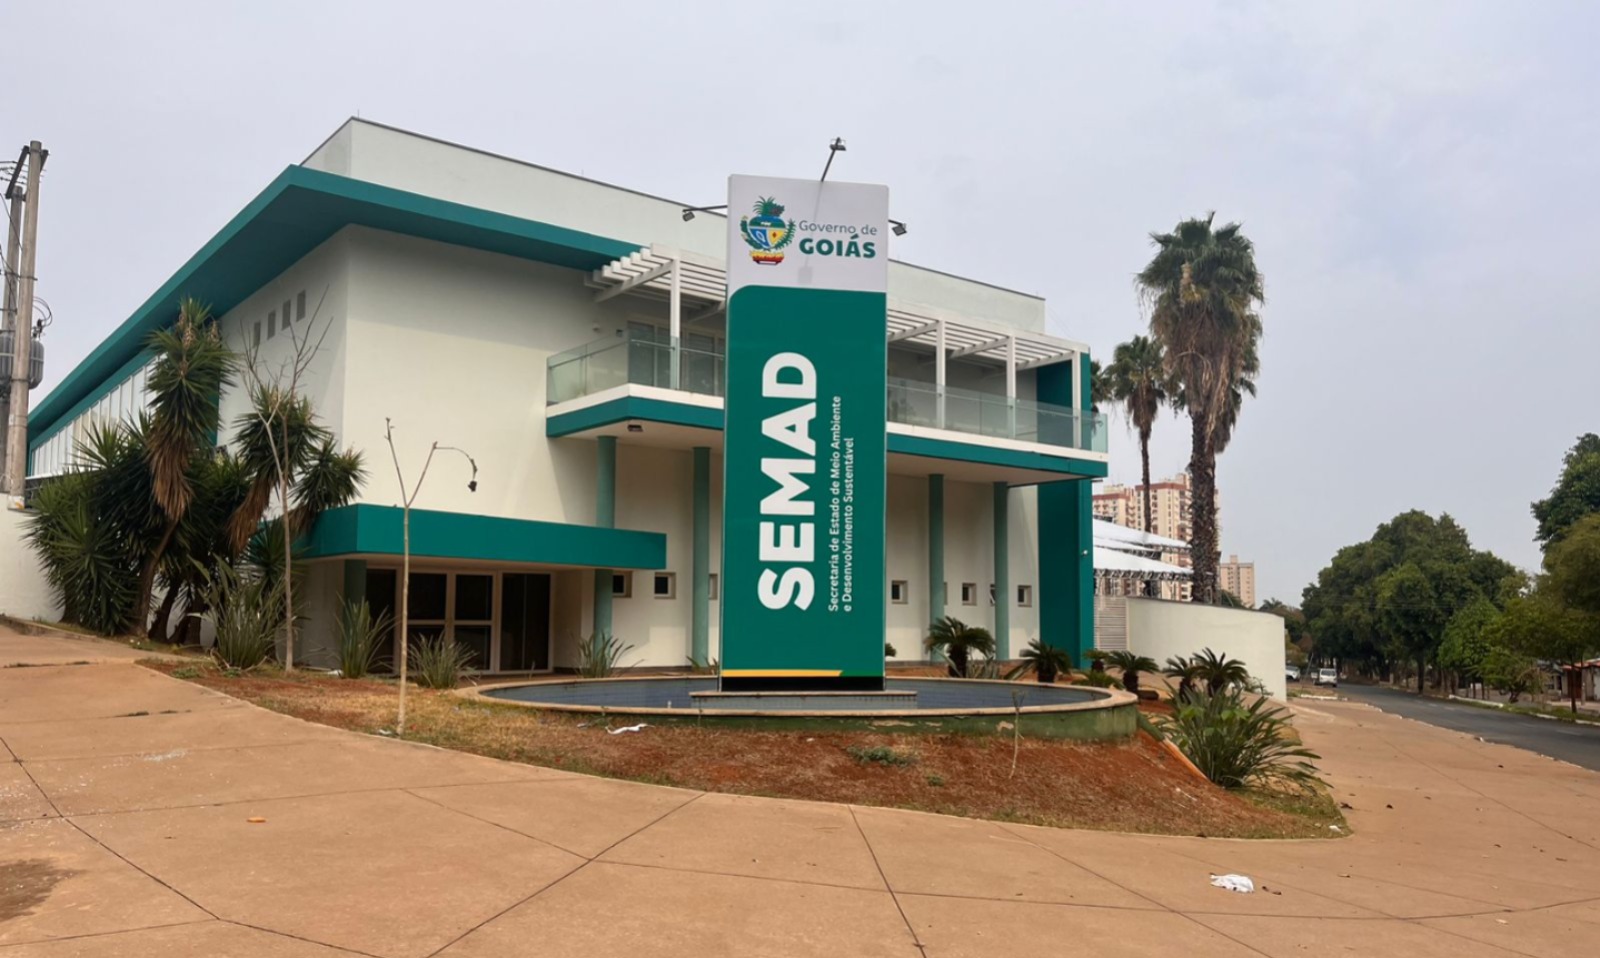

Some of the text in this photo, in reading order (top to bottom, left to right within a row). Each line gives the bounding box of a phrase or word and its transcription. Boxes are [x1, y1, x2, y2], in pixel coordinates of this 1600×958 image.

[799, 220, 877, 235] Governo de
[799, 234, 876, 259] GOIÁS
[758, 352, 817, 611] SEMAD
[828, 396, 841, 612] Secretaria de Estado de Meio Ambiente
[842, 438, 854, 612] e Desenvolvimento Sustentável
